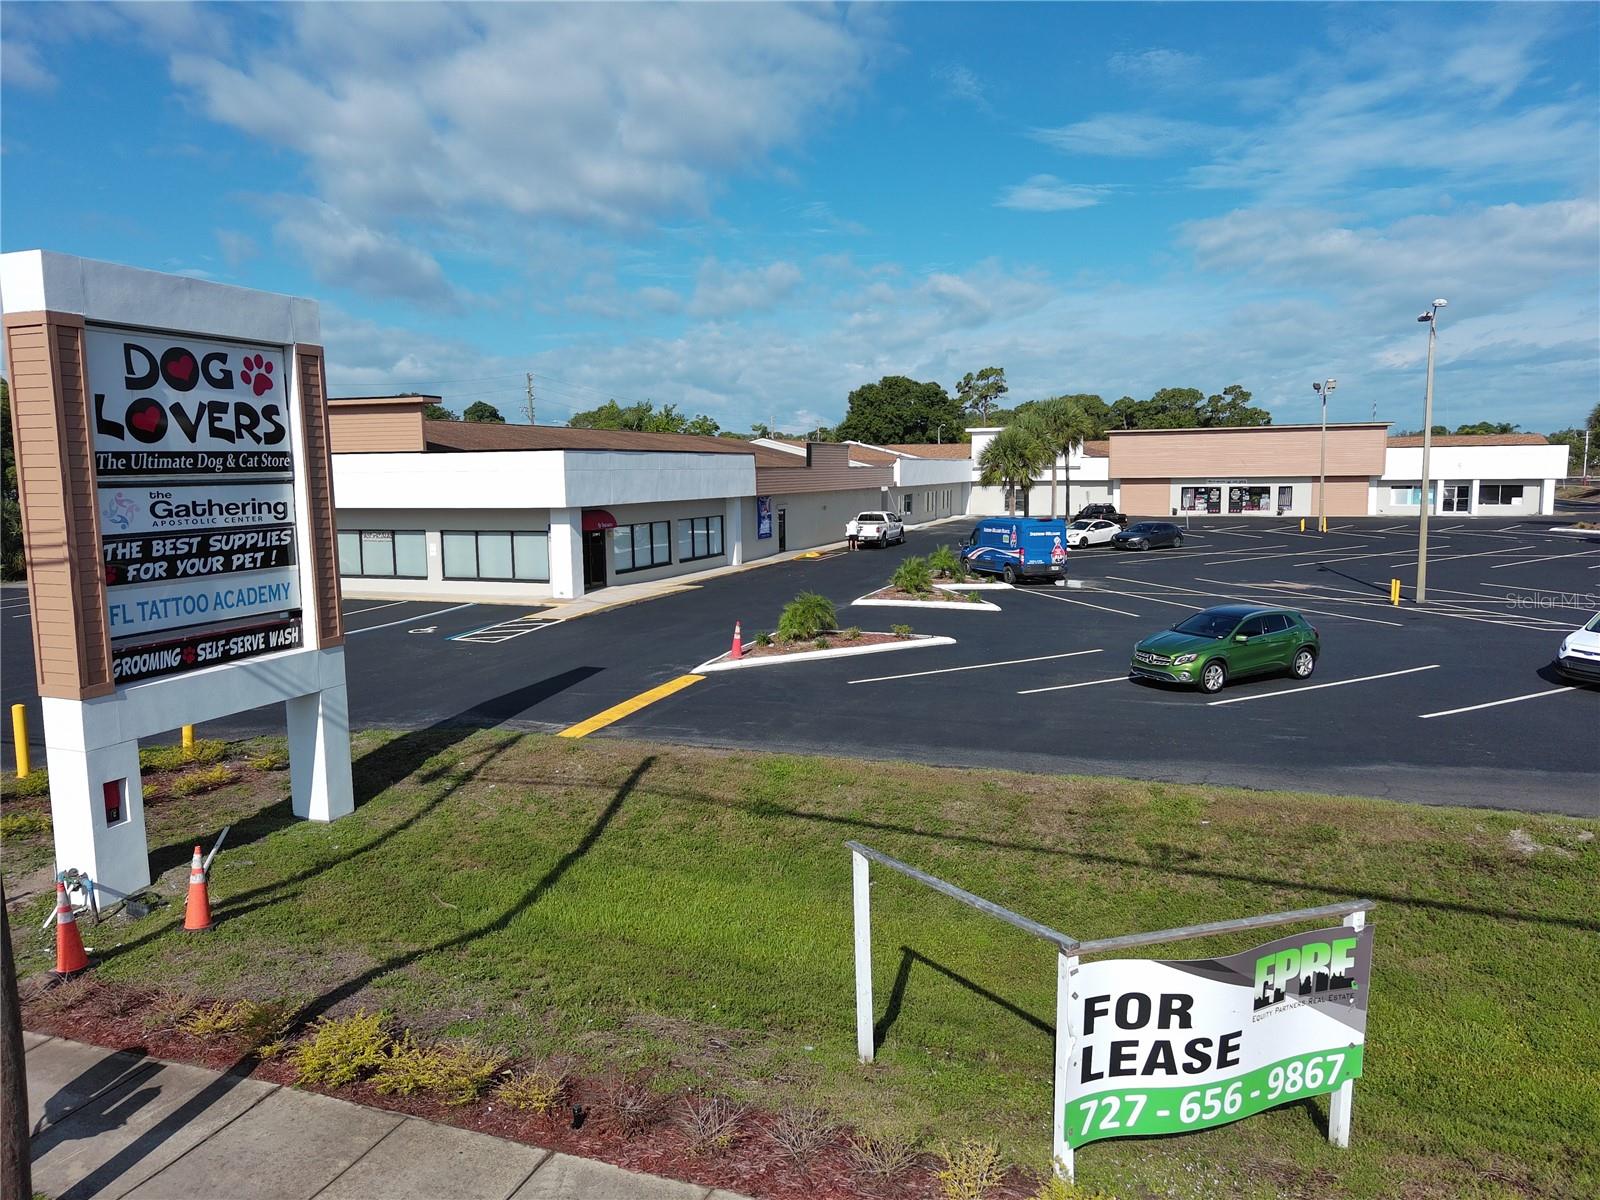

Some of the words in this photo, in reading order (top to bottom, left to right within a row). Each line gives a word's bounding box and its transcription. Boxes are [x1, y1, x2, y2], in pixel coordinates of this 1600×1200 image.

[124, 342, 234, 392] DOG
[94, 394, 286, 446] LOVERS
[97, 453, 126, 470] The
[131, 453, 193, 470] Ultimate
[197, 453, 223, 472] Dog
[227, 455, 236, 468] &
[239, 453, 258, 468] Cat
[260, 453, 290, 468] Store
[149, 498, 288, 520] Gathering
[150, 491, 172, 500] the
[152, 518, 217, 527] APOSTOLIC
[224, 516, 264, 524] CENTER
[104, 542, 142, 562] THE
[152, 537, 201, 556] BEST
[208, 530, 292, 551] SUPPLIES
[127, 562, 167, 581] FOR
[176, 558, 224, 576] YOUR
[231, 552, 264, 570] PET
[110, 604, 134, 626] FL
[136, 592, 209, 622] TATTOO
[213, 582, 291, 611] ACADEMY
[112, 647, 182, 678] GROOMING
[196, 632, 266, 662] SELF-SERVE
[268, 626, 300, 648] WASH
[1253, 938, 1357, 1010] EPRE
[1083, 991, 1194, 1036] FOR
[1080, 1030, 1242, 1084] LEASE
[1079, 1094, 1148, 1136] 727
[1179, 1081, 1243, 1124] 656
[1267, 1054, 1346, 1100] 9867
